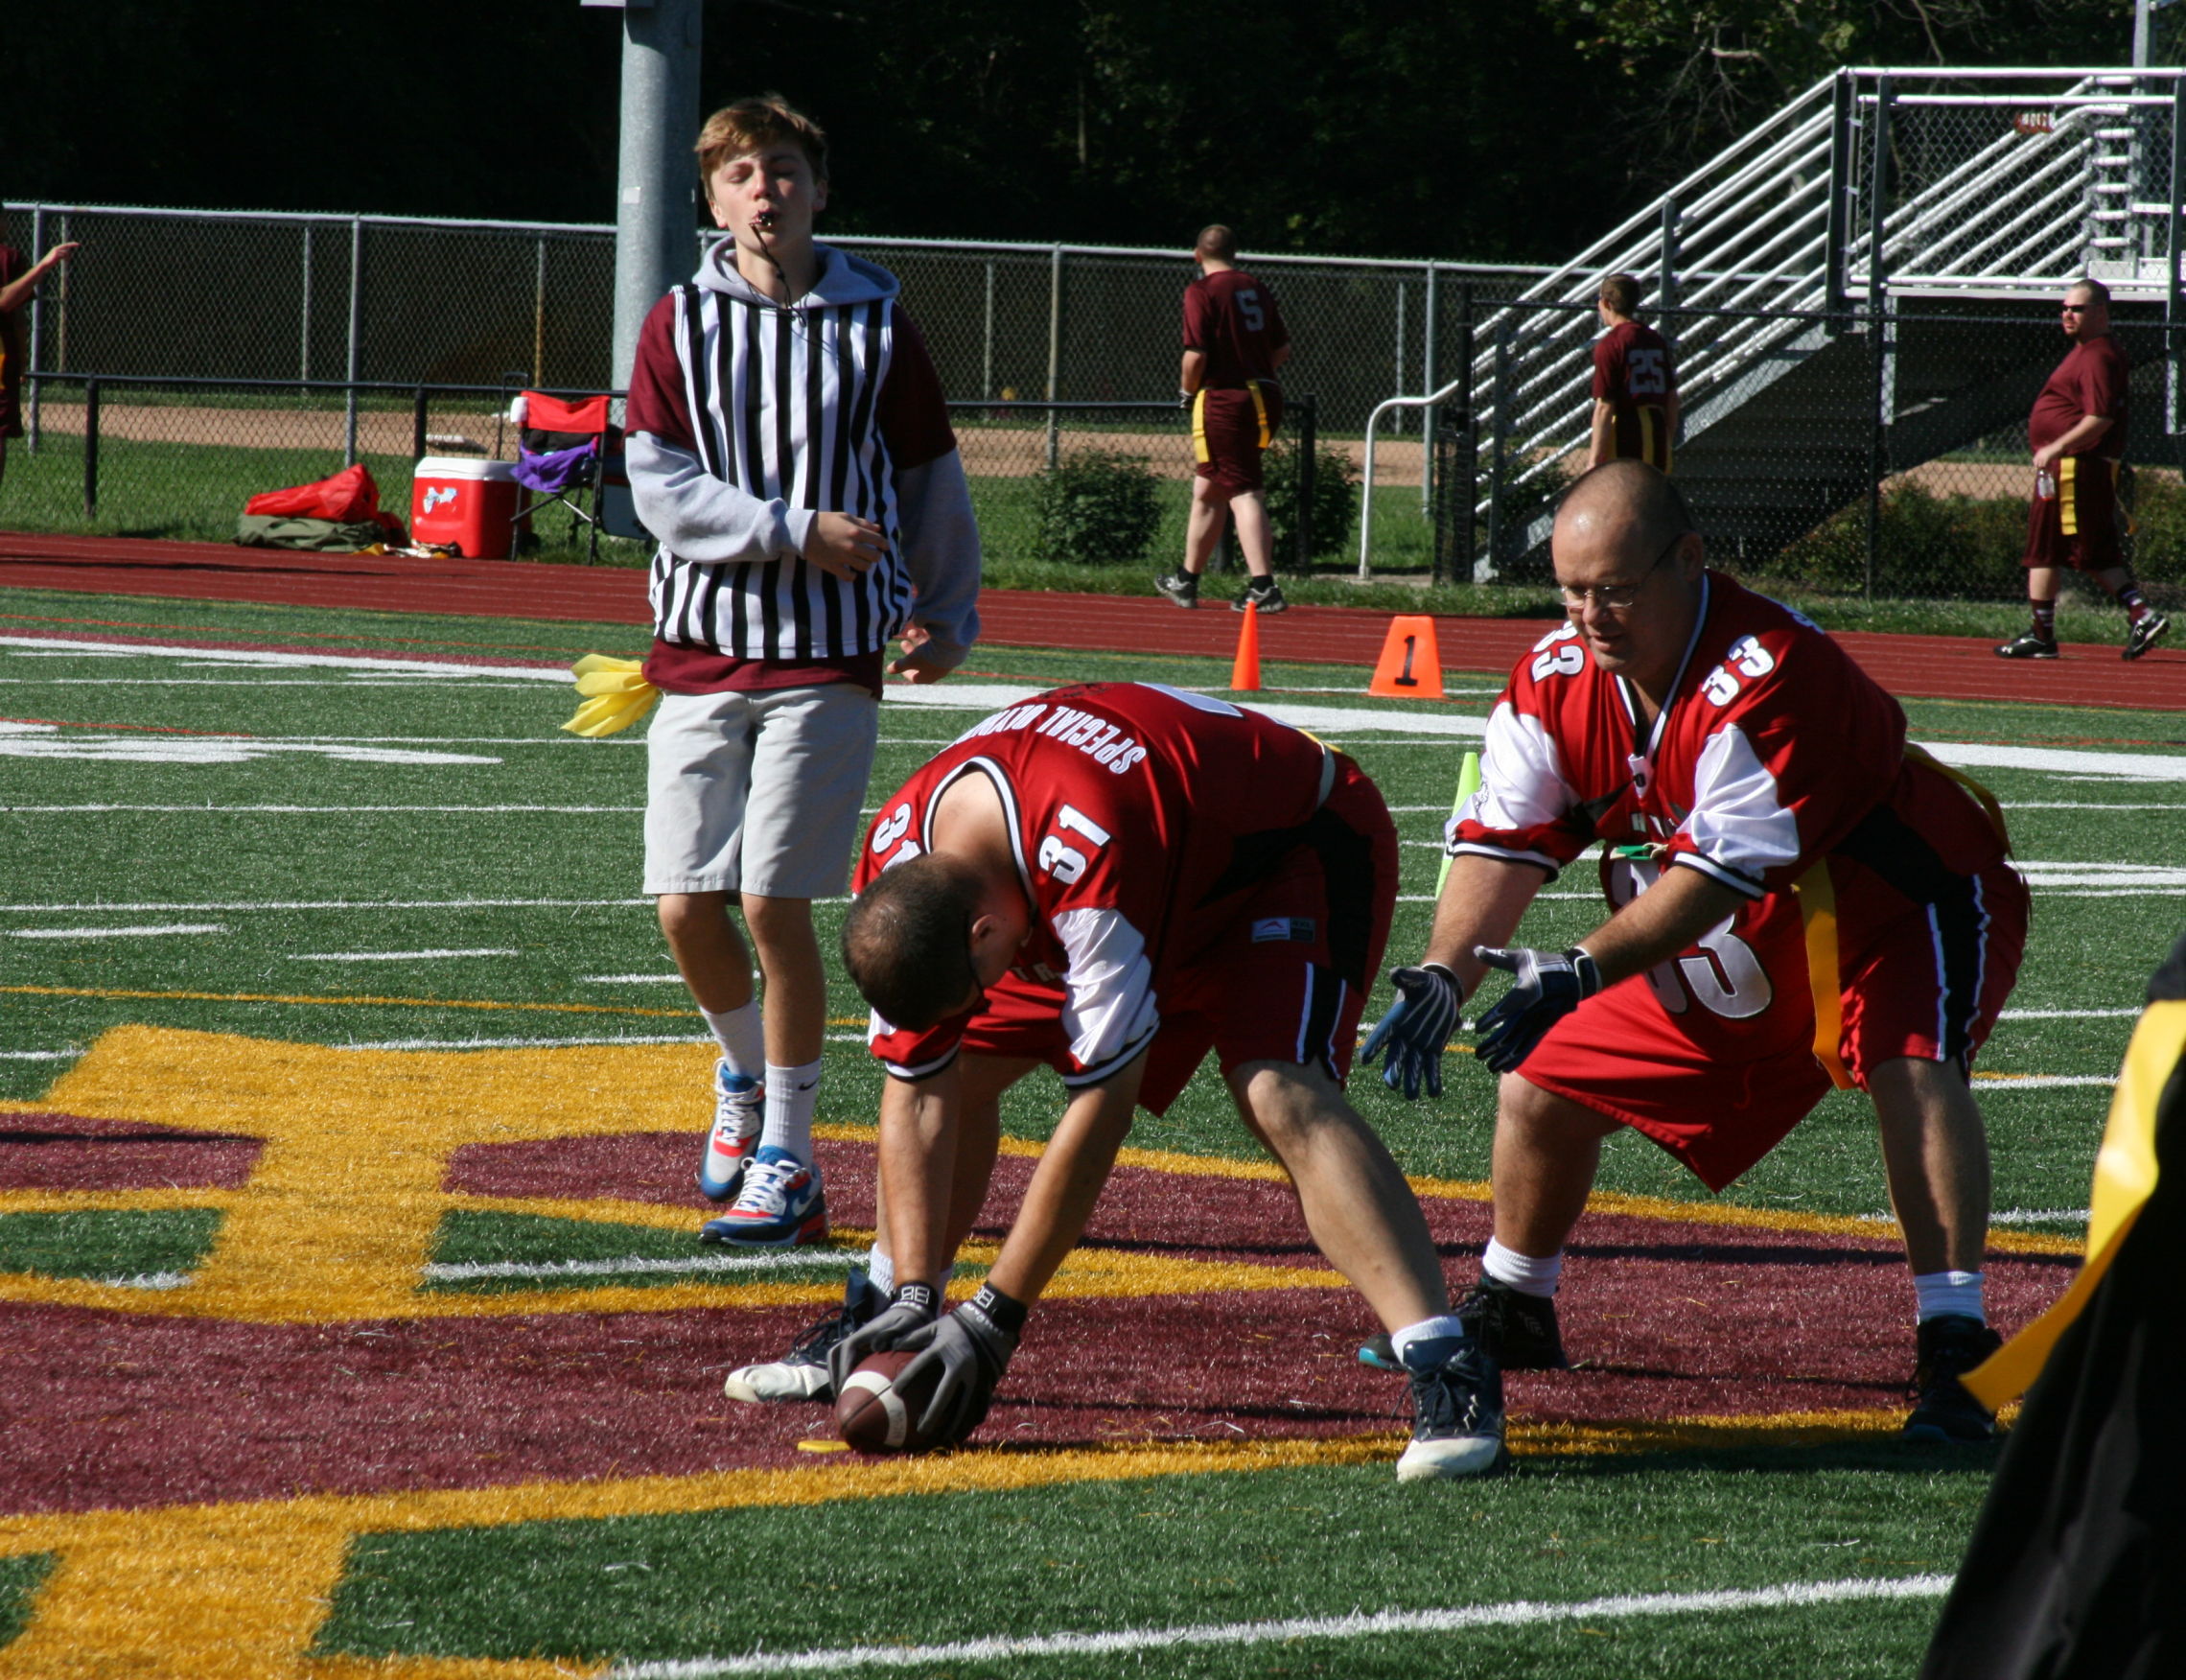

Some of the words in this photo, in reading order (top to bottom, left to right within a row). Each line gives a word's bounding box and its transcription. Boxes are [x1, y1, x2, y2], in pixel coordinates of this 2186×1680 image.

[1235, 290, 1264, 331] 5
[1629, 349, 1665, 394] 25
[1394, 635, 1418, 687] 1
[1701, 634, 1775, 707] 33
[1035, 705, 1147, 775] SPECIAL
[1038, 804, 1111, 885] 31
